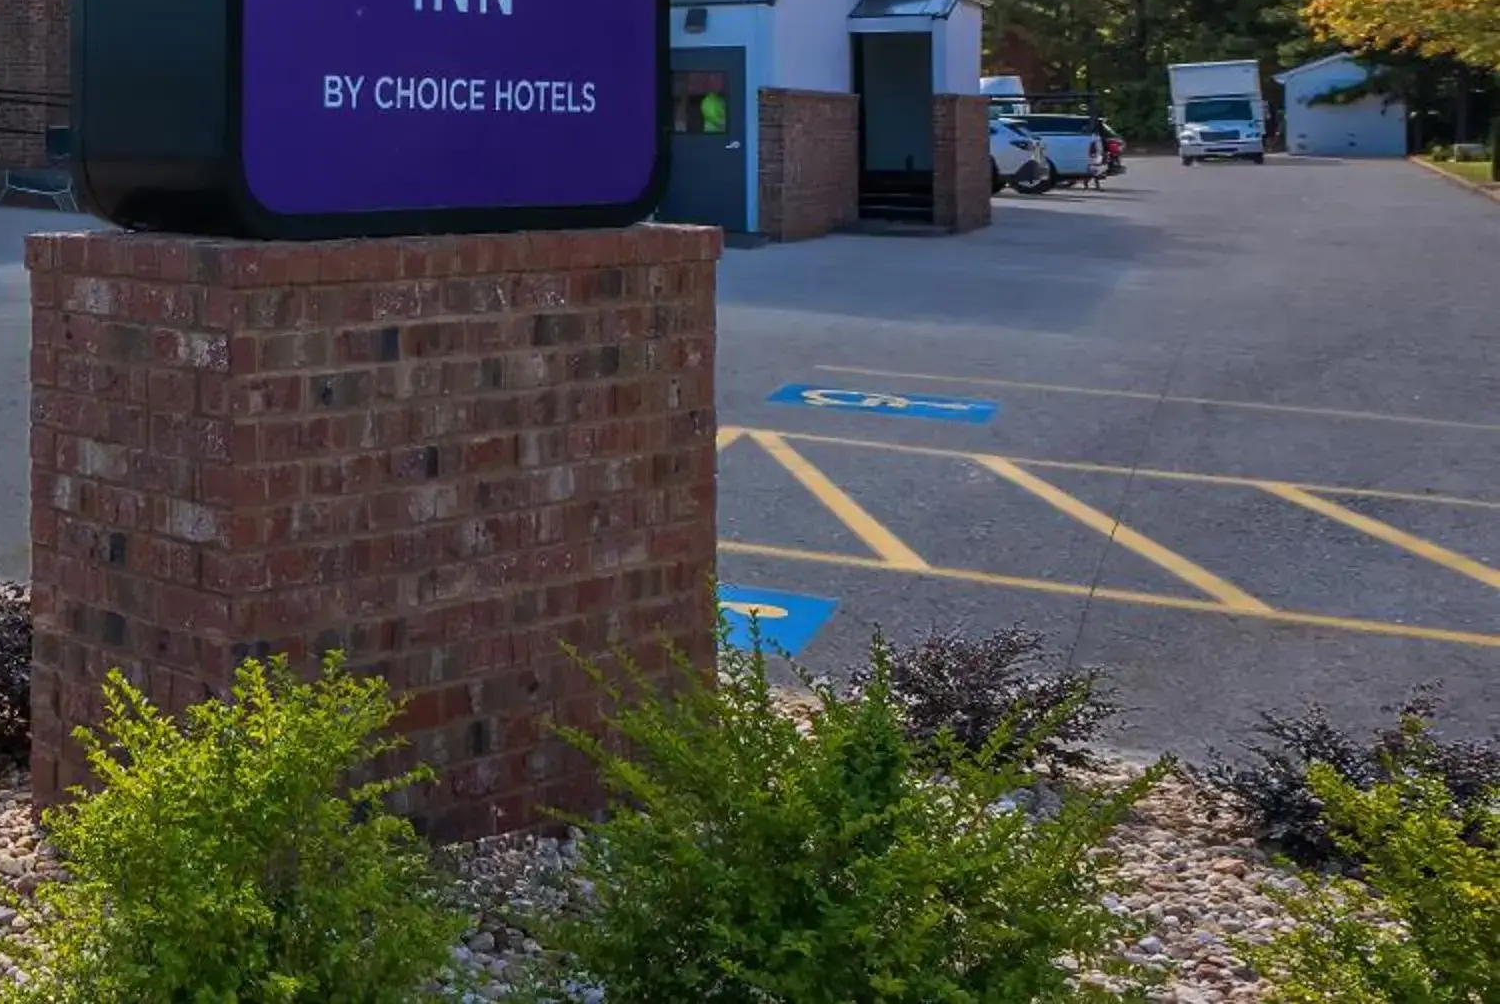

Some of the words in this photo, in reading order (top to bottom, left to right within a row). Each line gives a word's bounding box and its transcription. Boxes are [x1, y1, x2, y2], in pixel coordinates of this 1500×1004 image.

[323, 74, 366, 109] BY
[374, 76, 487, 111] CHOICE
[495, 79, 597, 113] HOTELS
